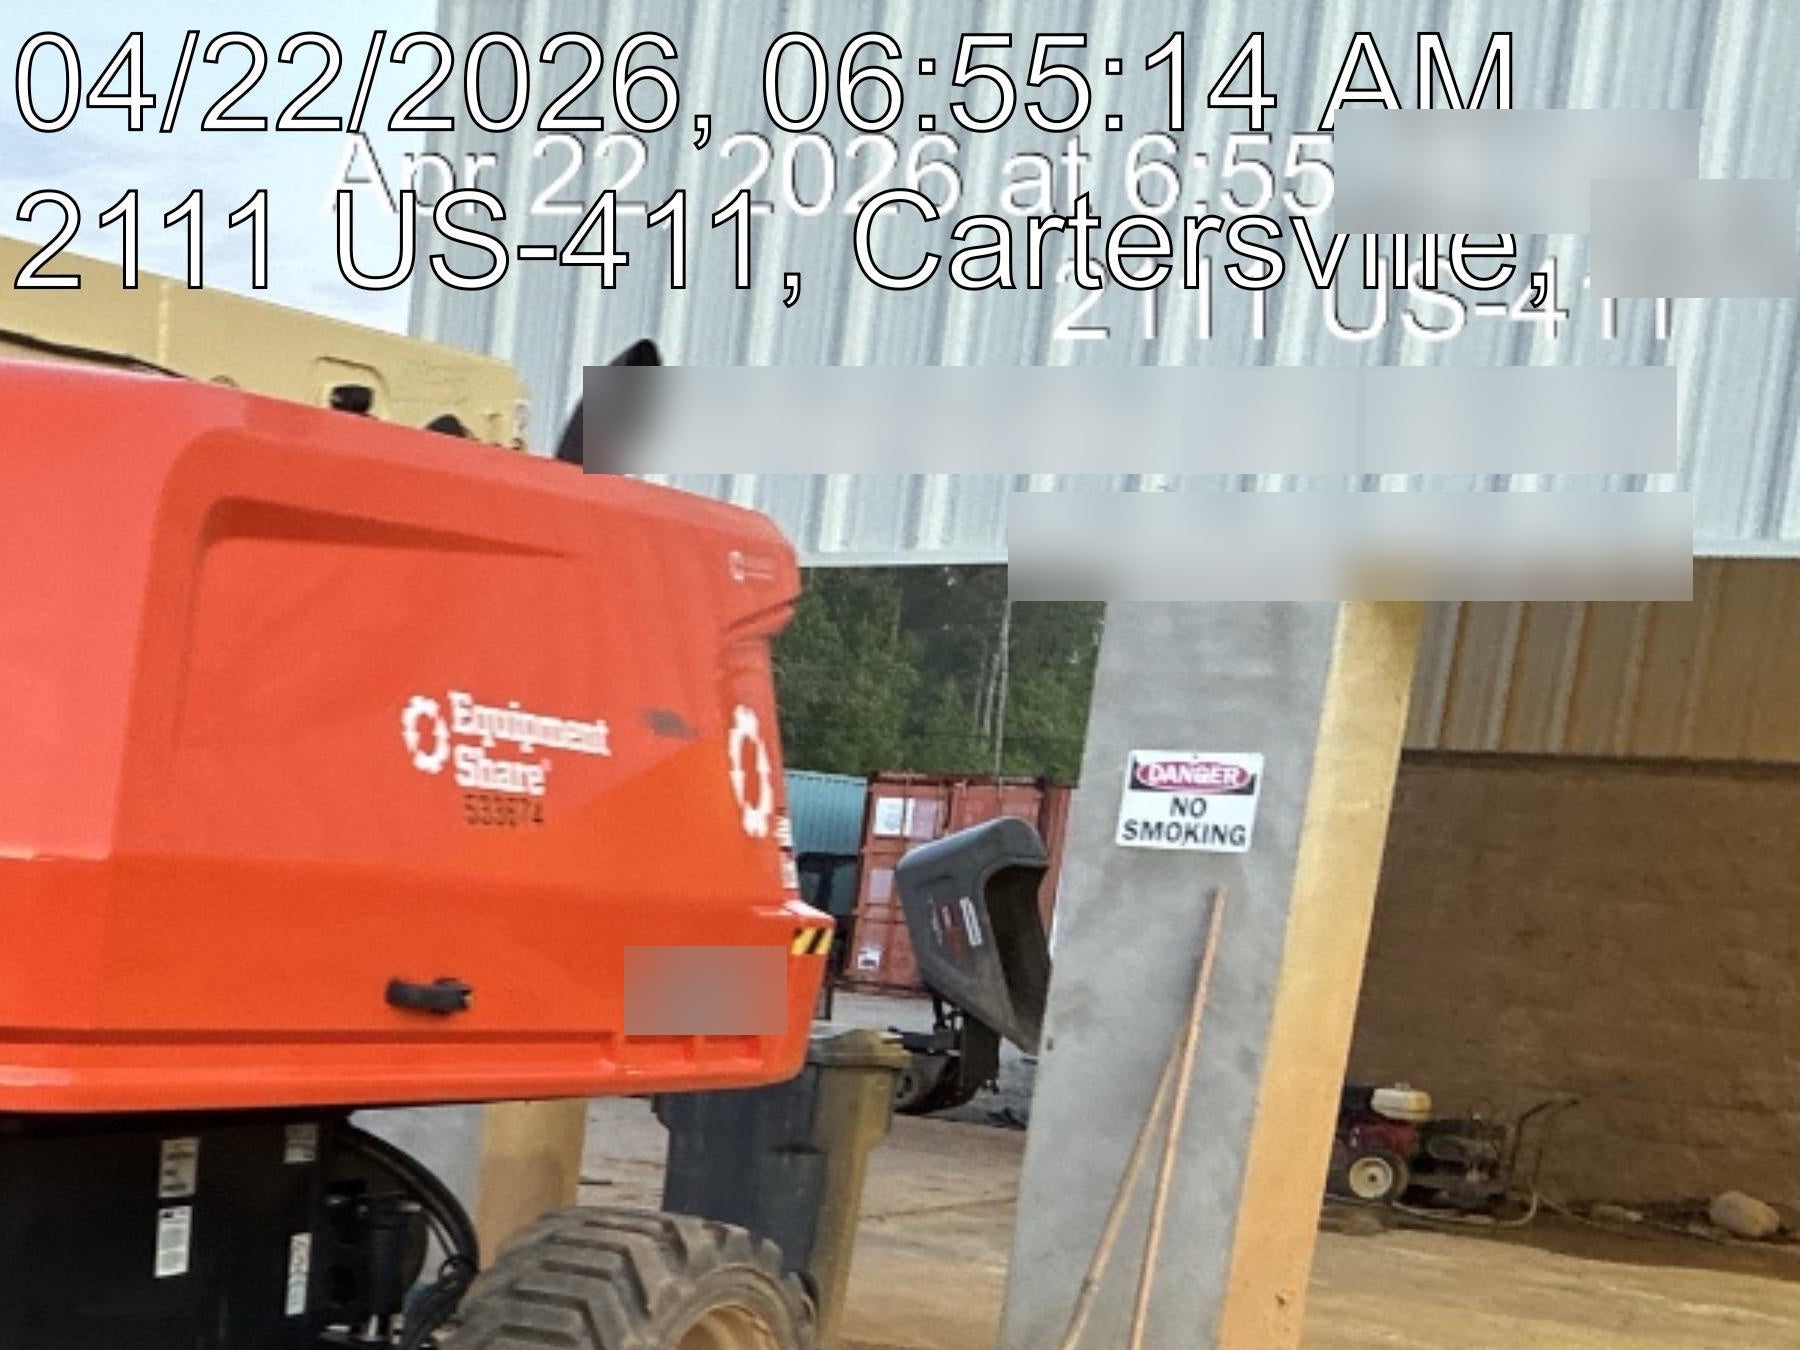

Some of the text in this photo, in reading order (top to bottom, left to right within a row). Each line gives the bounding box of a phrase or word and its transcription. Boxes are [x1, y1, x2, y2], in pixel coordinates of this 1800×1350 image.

[448, 690, 612, 757] Equipment
[454, 743, 546, 797] Share
[1148, 763, 1239, 787] DANGER
[1170, 797, 1207, 818] NO
[1122, 819, 1246, 847] SMOKING
